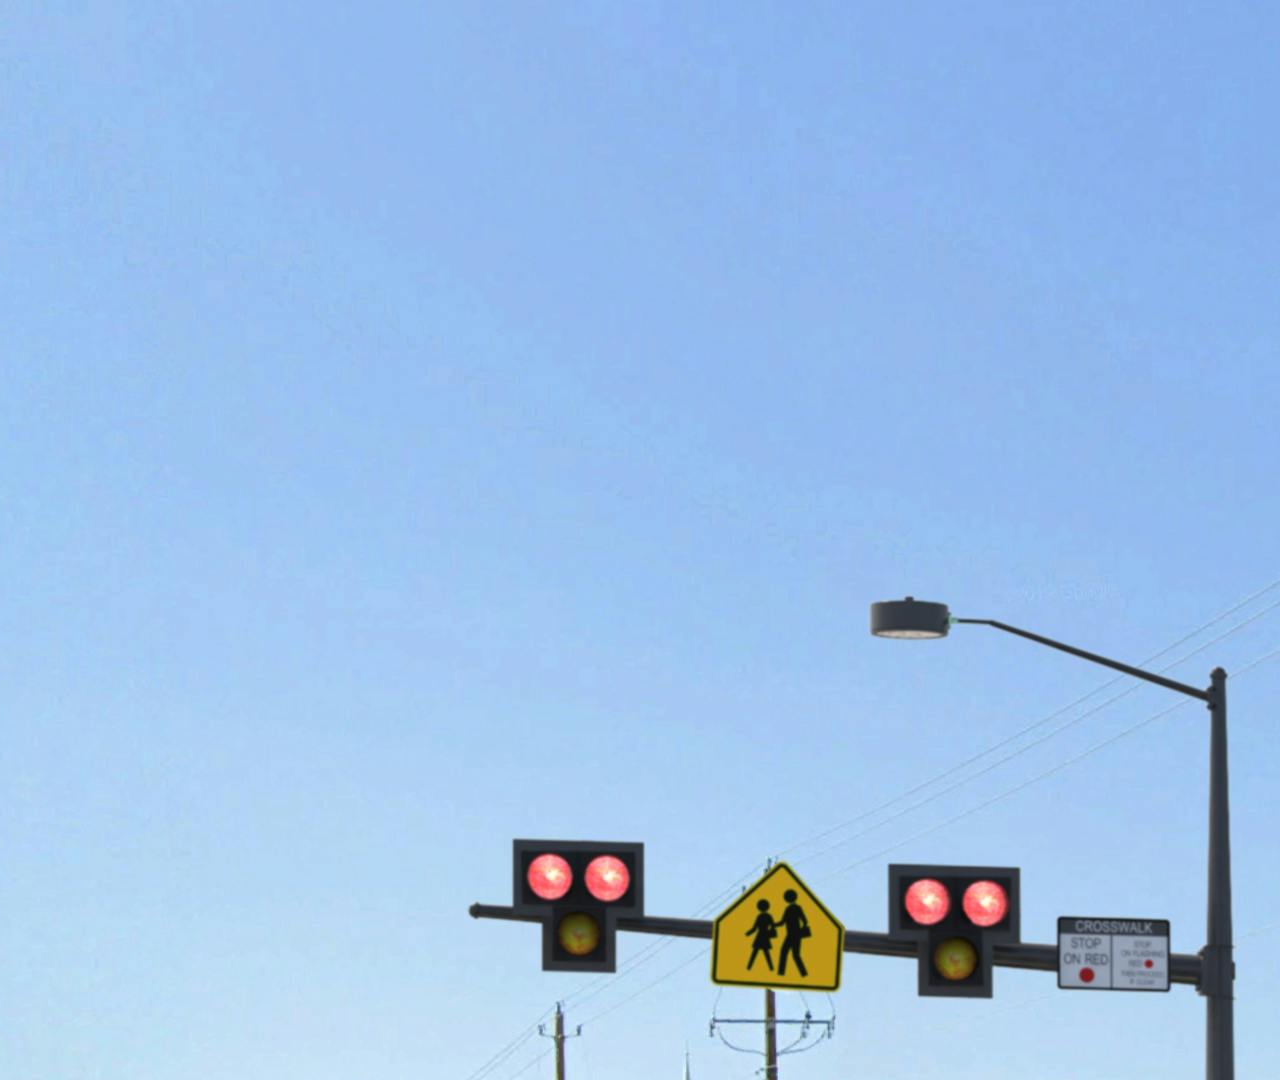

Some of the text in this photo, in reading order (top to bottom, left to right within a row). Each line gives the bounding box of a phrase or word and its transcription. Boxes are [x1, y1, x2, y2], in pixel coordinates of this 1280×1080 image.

[1075, 920, 1153, 934] CROSSWALK
[1070, 937, 1102, 949] STOP
[1063, 952, 1109, 966] ON RED
